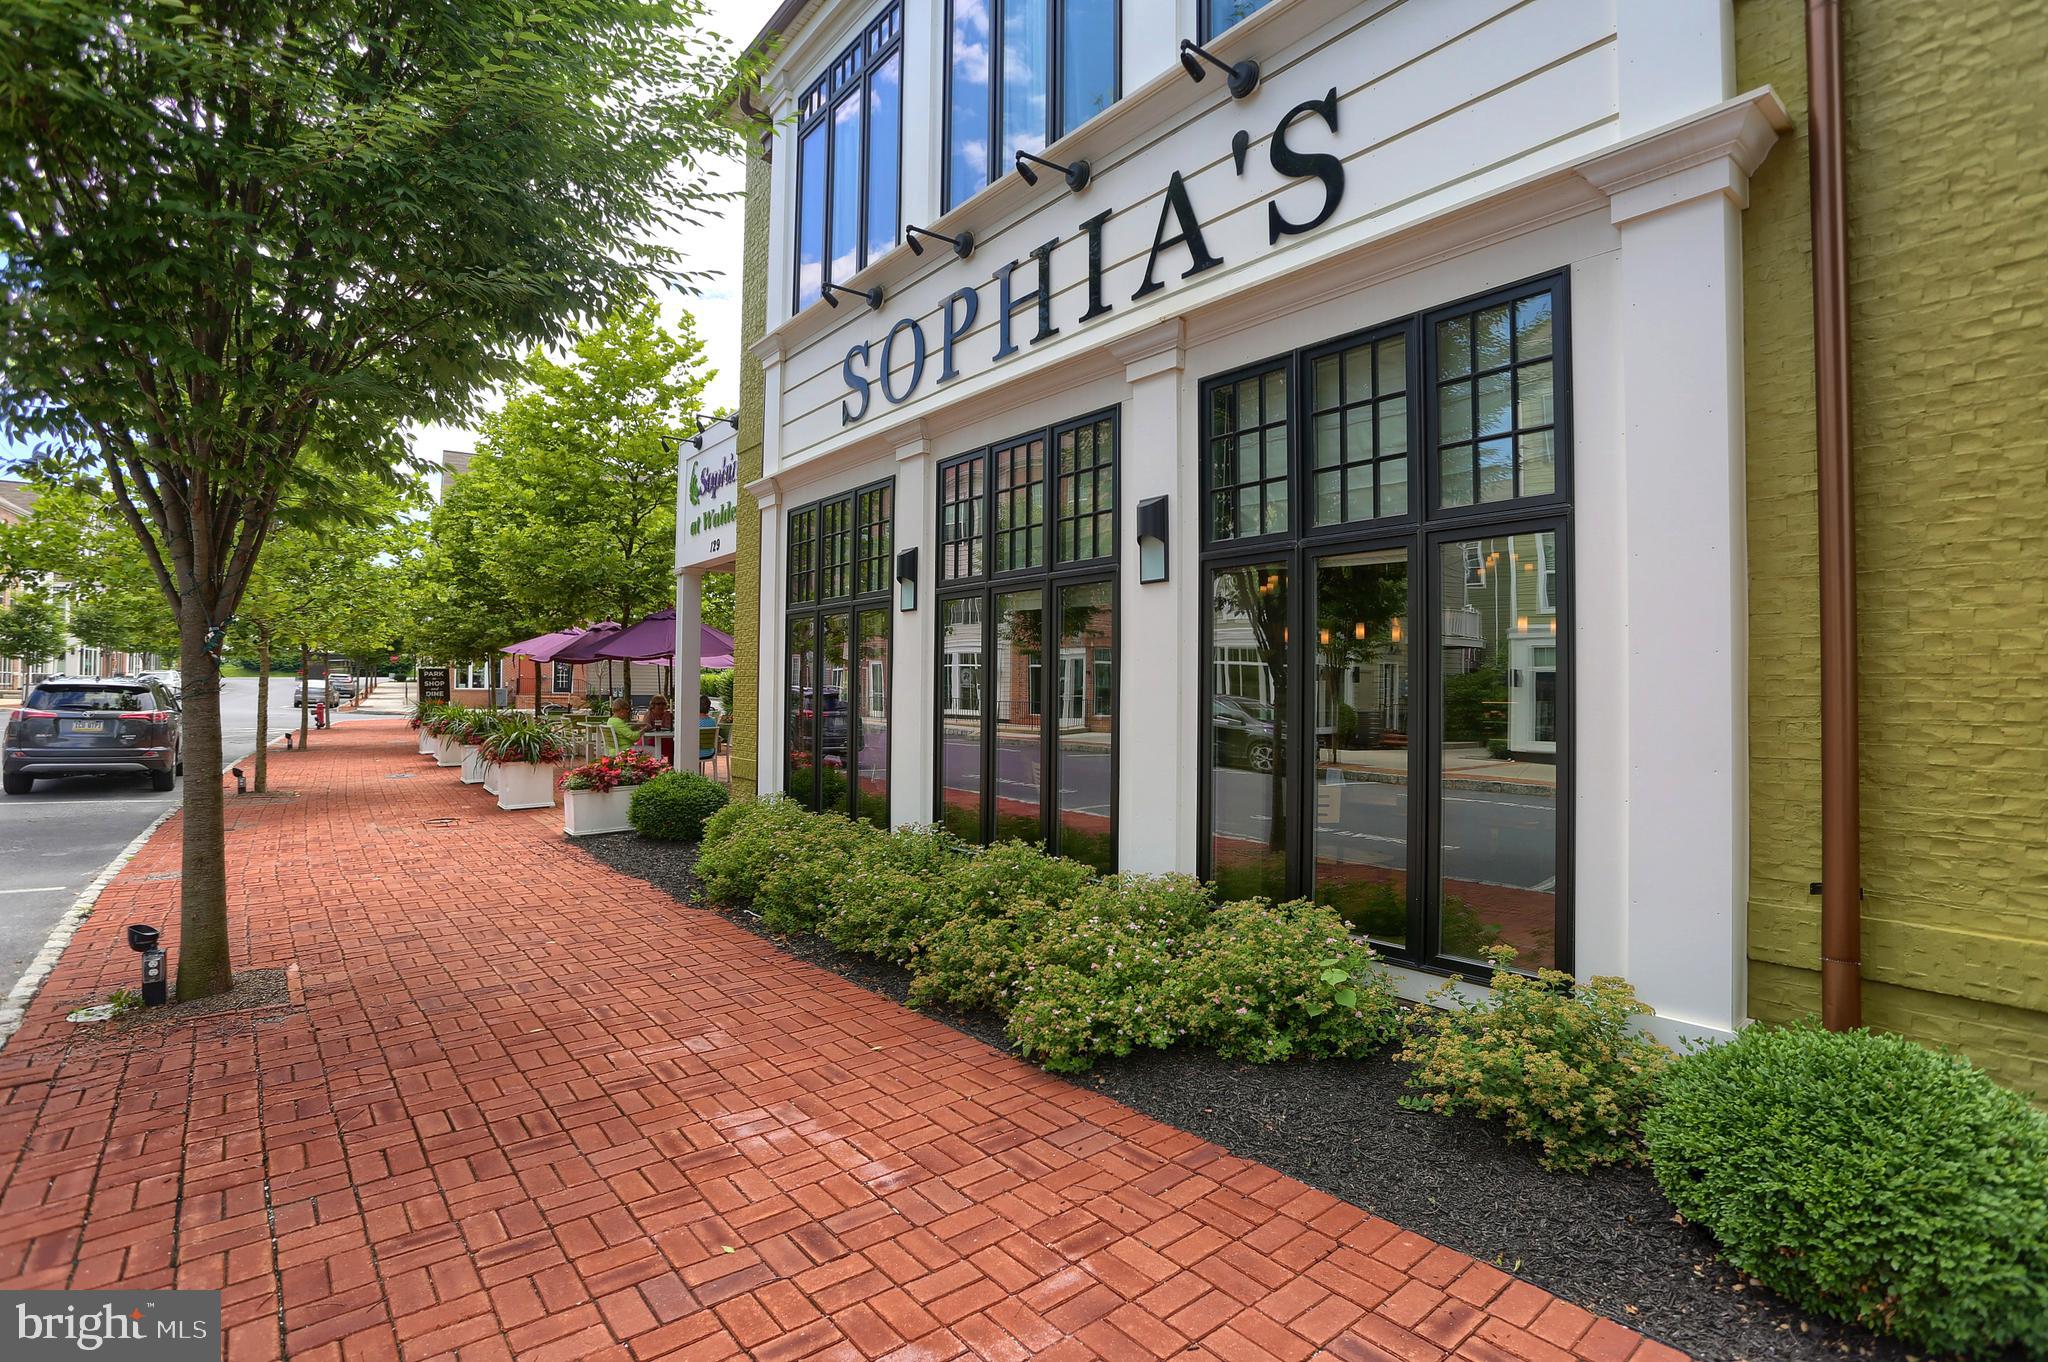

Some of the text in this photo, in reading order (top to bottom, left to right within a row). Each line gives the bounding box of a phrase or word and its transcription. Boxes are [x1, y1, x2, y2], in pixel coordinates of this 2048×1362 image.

[841, 86, 1346, 427] SOPHIA'S
[690, 516, 701, 536] at
[710, 538, 721, 552] 129
